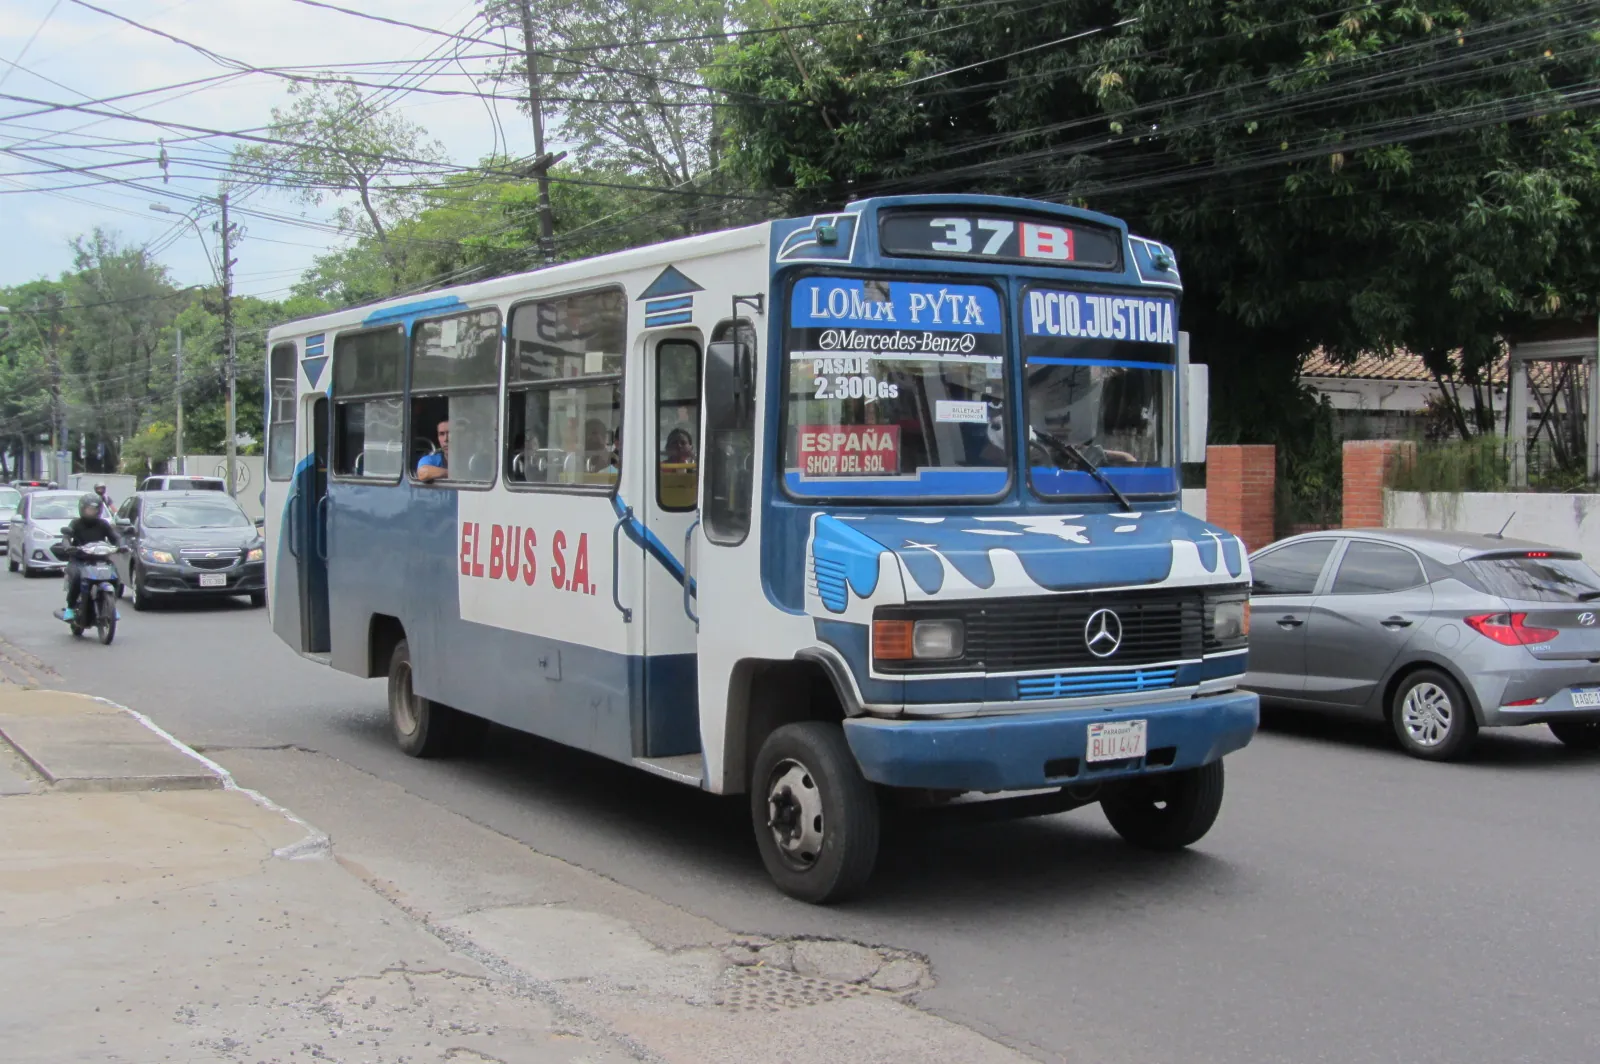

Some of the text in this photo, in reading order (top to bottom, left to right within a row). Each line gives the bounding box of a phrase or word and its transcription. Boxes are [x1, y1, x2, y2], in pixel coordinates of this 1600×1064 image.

[929, 217, 1069, 260] 37B
[909, 287, 985, 325] PYTA
[1029, 291, 1174, 344] PCIO.JUSTICIA
[836, 329, 960, 352] Mercedes-Benz
[813, 358, 869, 374] PASAJE
[801, 428, 894, 452] ESPAÑA
[217, 465, 246, 482] DX
[806, 454, 885, 473] SHOP. DEL SOL
[460, 522, 596, 596] EL BUS S.A.
